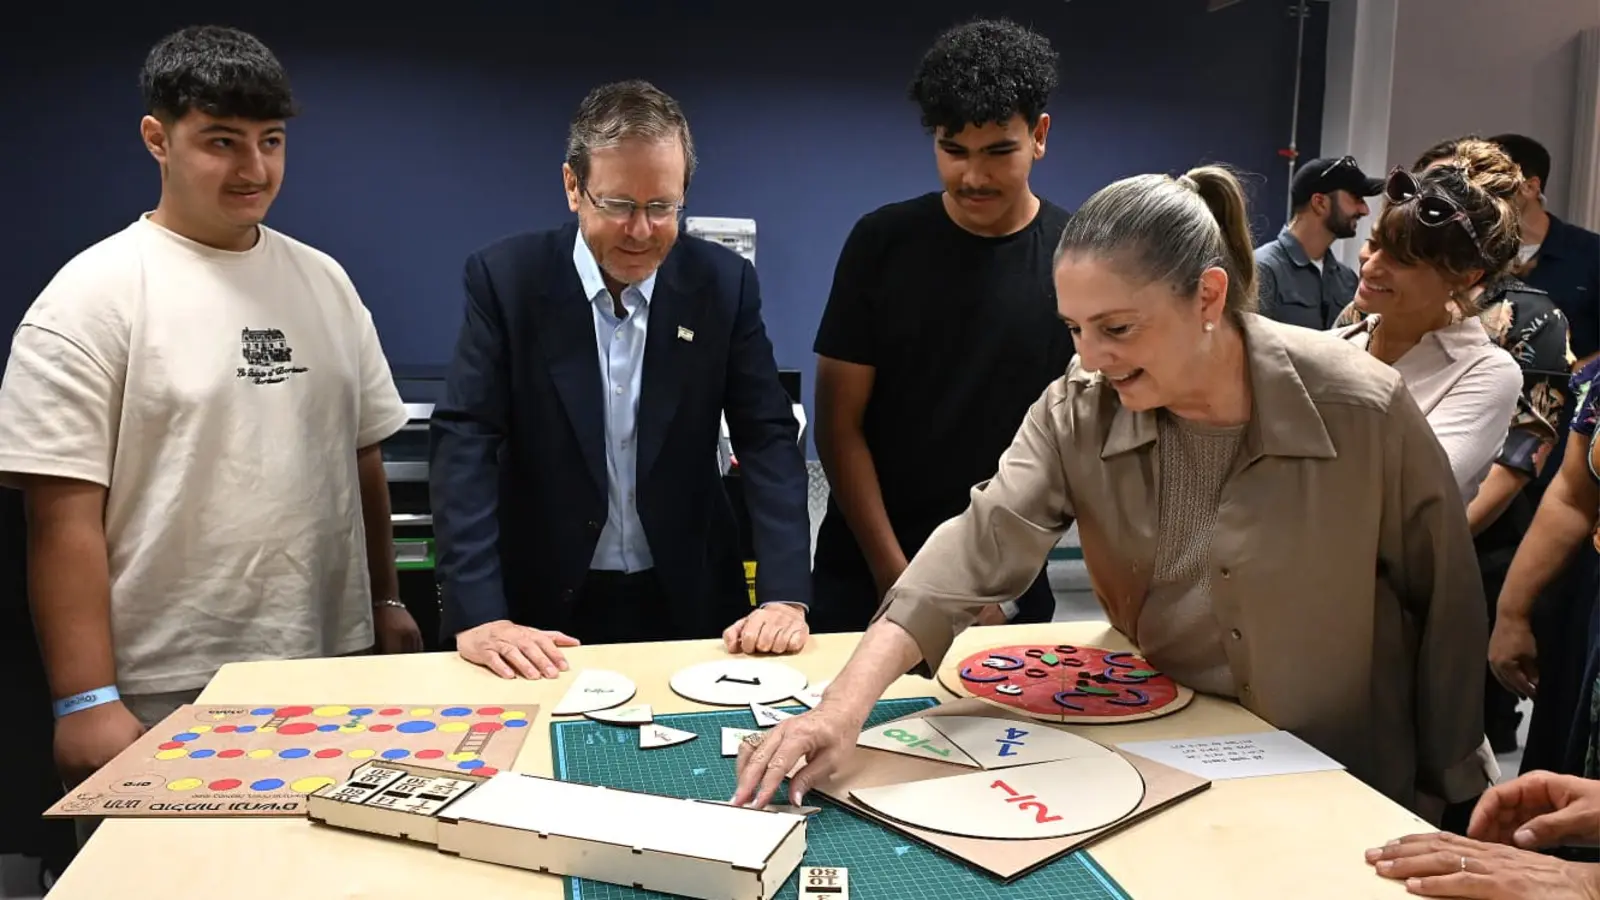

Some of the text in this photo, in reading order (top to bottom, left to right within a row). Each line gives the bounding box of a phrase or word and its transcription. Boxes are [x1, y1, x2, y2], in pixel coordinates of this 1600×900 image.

[714, 674, 761, 686] 1
[148, 802, 299, 812] סולמות ונחשים
